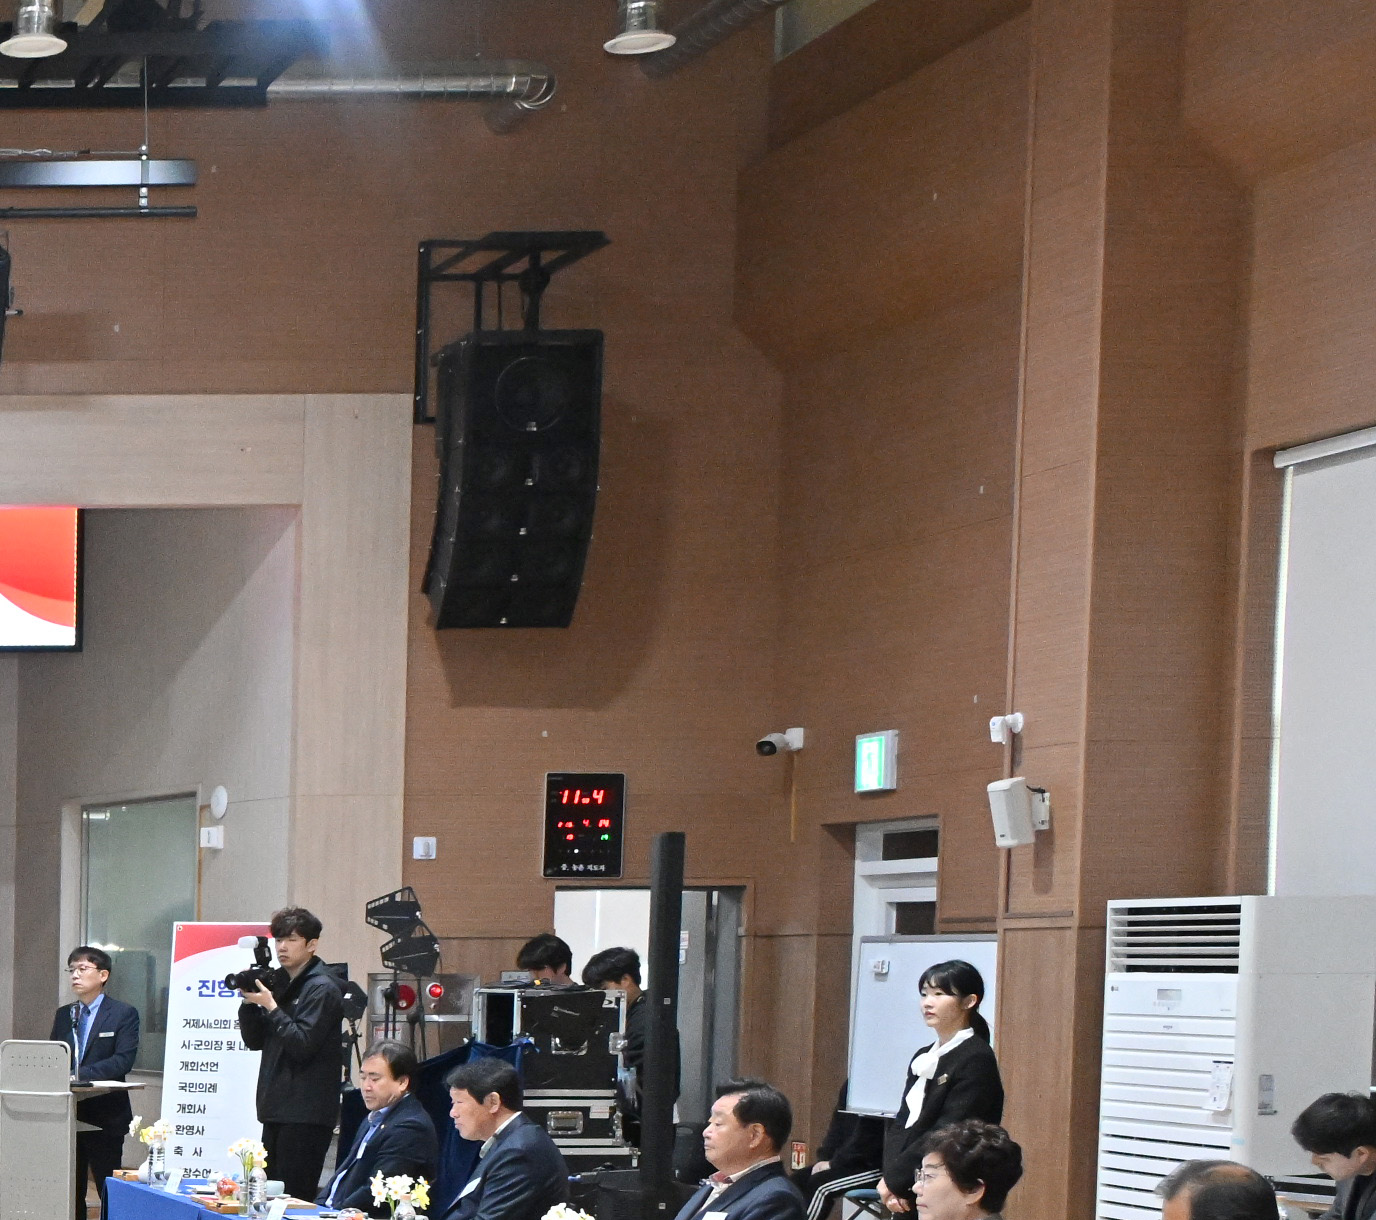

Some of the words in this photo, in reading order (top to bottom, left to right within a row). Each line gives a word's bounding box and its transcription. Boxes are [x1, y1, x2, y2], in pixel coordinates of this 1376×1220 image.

[198, 979, 242, 998] 진행
[226, 1040, 236, 1052] 및
[179, 1060, 219, 1073] 개회선언
[178, 1081, 218, 1094] 국민의례
[176, 1103, 207, 1115] 개회사
